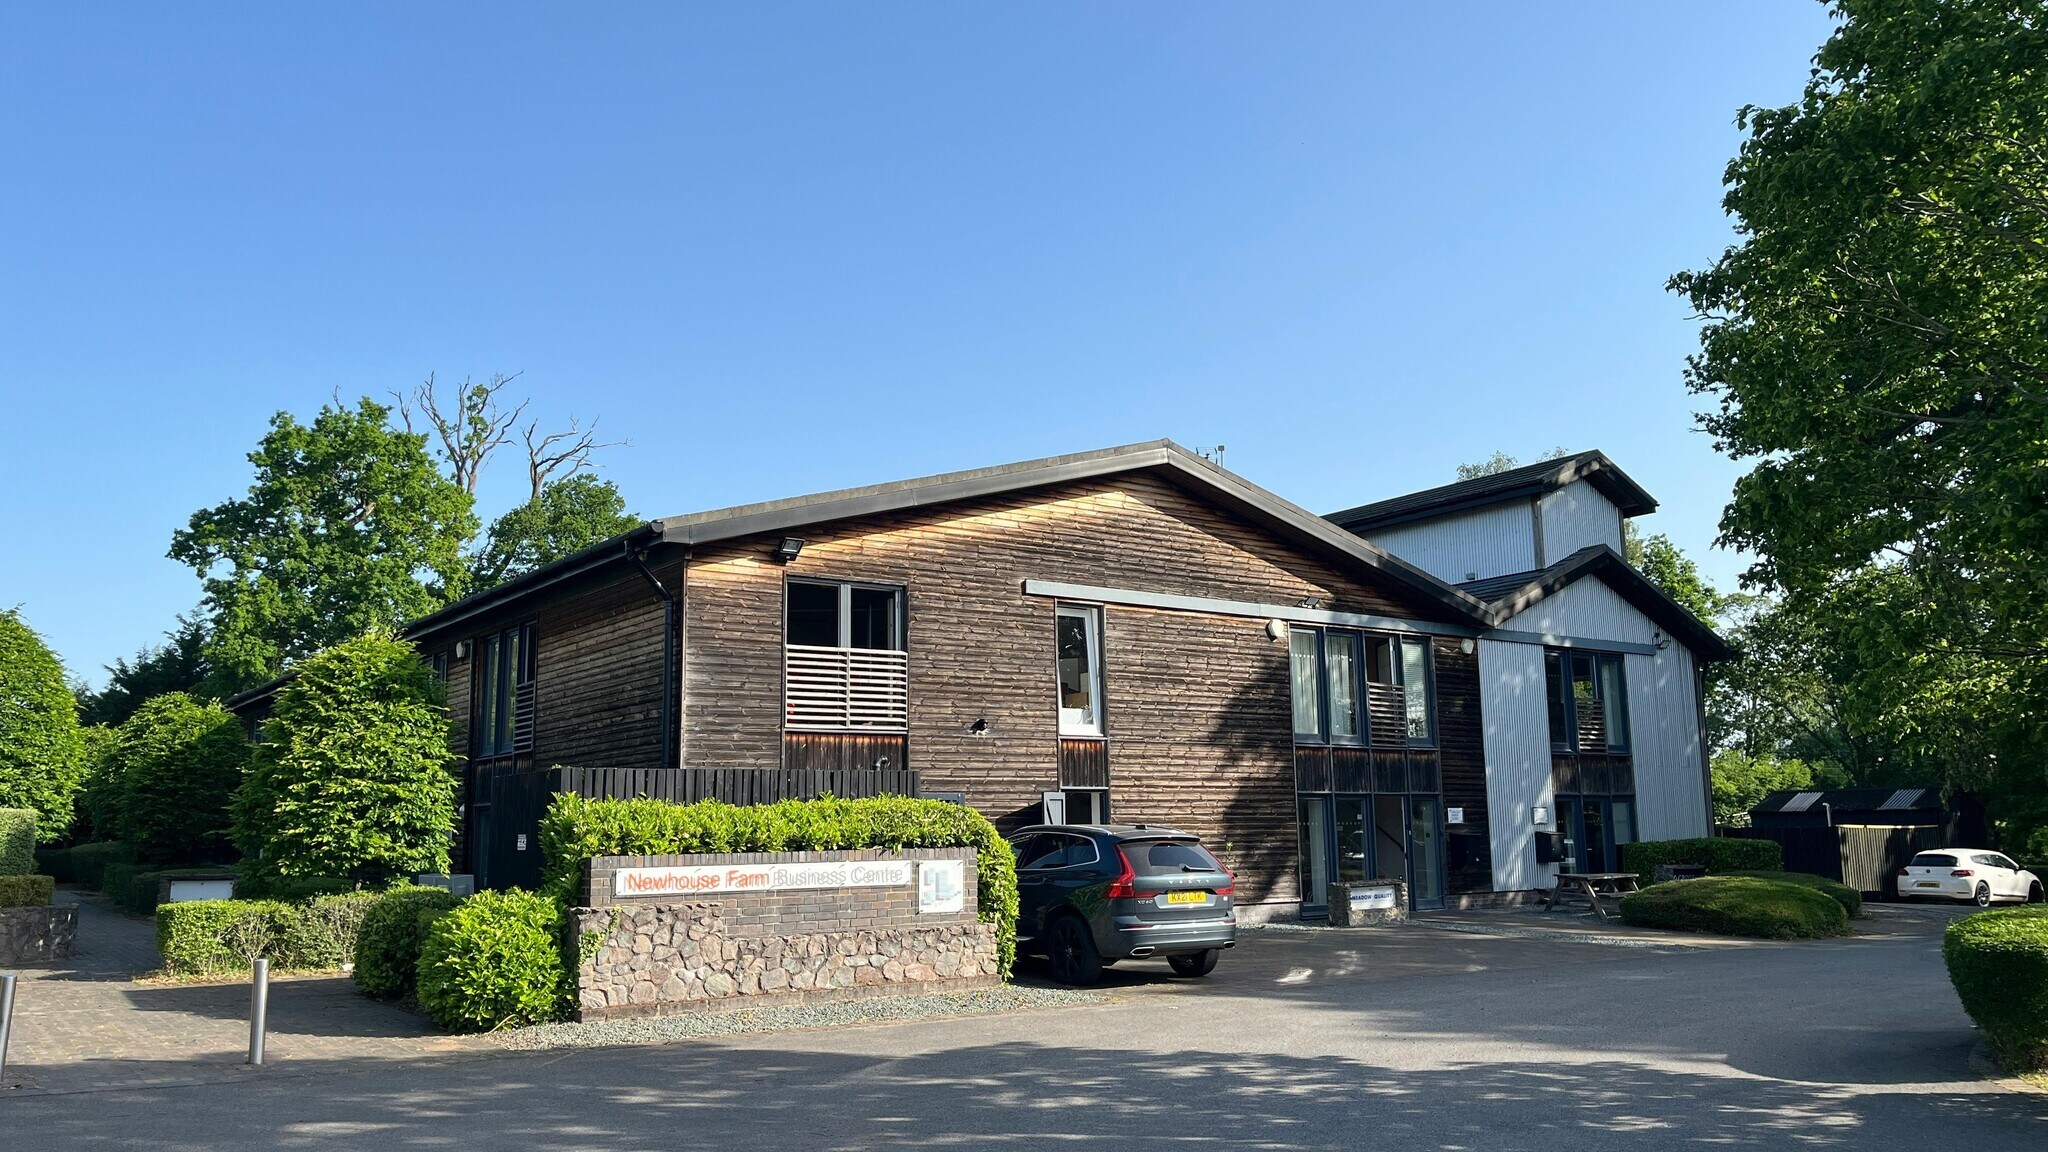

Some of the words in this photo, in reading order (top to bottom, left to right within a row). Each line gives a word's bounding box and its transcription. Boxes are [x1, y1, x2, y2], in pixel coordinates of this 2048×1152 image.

[625, 872, 720, 892] Newhouse
[726, 870, 769, 888] Farm
[774, 868, 846, 886] Business
[851, 866, 903, 883] Centre
